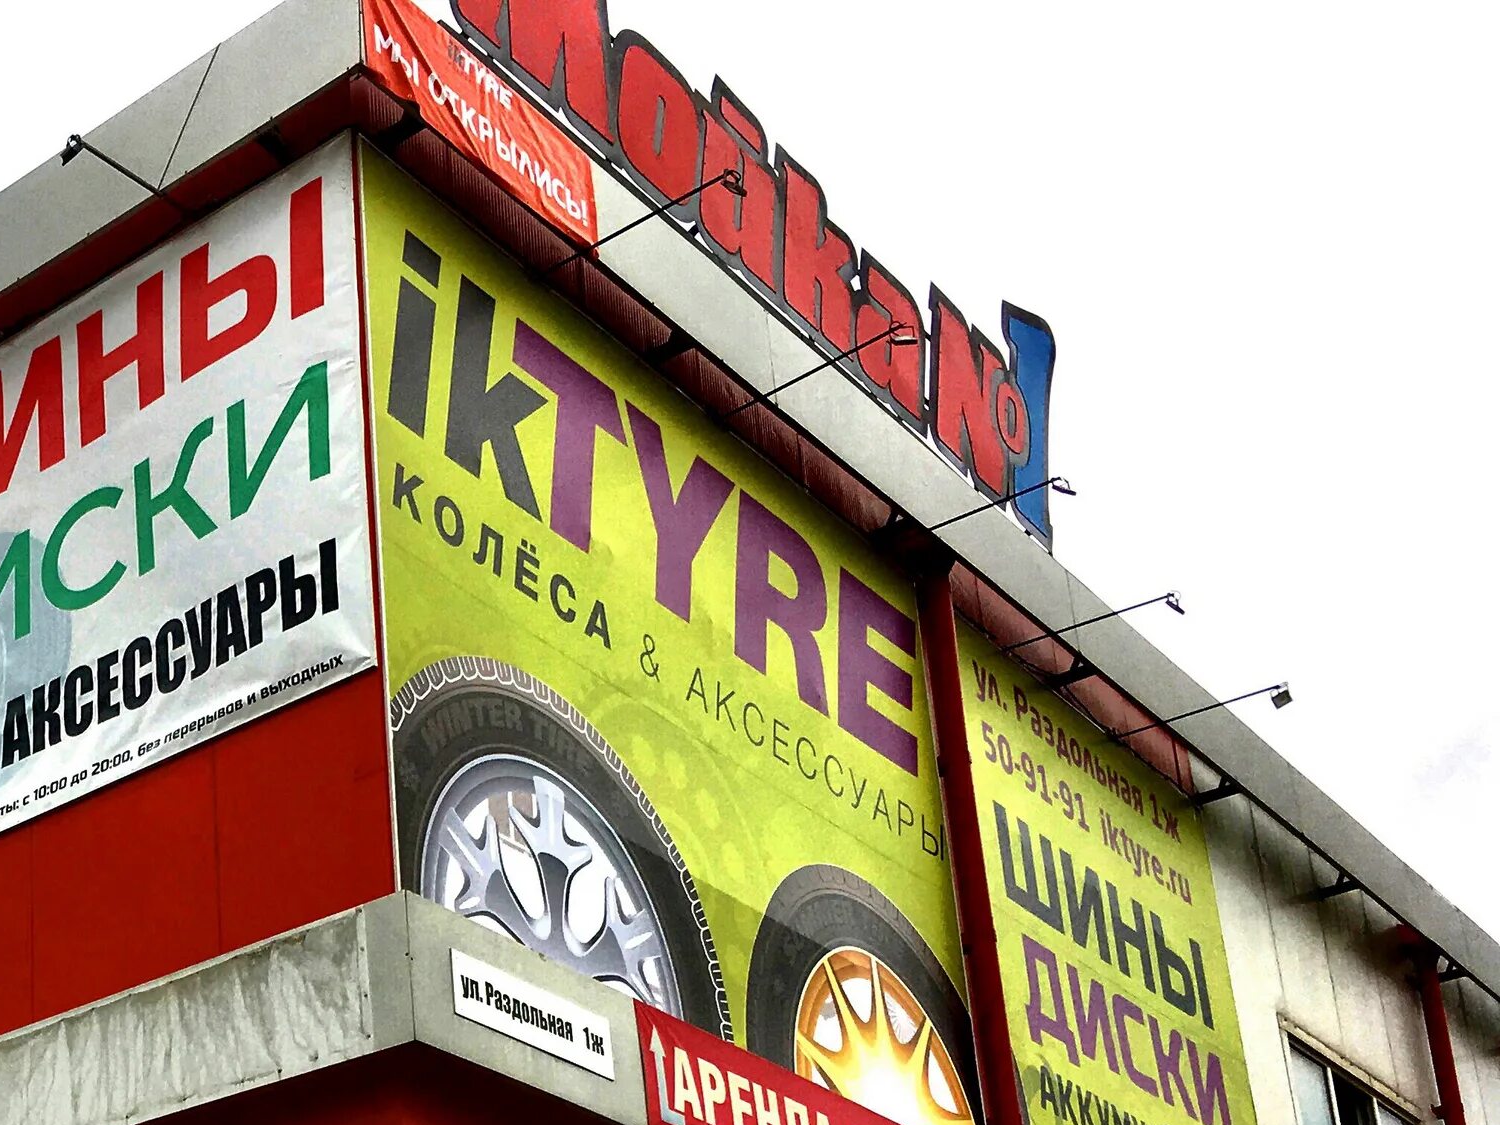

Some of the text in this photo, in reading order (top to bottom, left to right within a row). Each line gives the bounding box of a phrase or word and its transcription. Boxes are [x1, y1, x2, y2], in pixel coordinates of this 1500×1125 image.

[374, 23, 588, 226] МЫ ОТКРЫЛИСЬ!
[386, 229, 919, 778] ikTYRE
[1, 538, 340, 768] АКСЕССУАРЫ
[22, 793, 31, 807] с
[33, 777, 68, 801] 10:00
[69, 769, 89, 791] до
[91, 749, 134, 778] 20:00,
[137, 736, 162, 759] без
[163, 696, 244, 750] перерывов
[245, 691, 258, 708] и
[260, 653, 345, 702] выходных
[391, 461, 946, 862] КОЛЁСА & АКСЕССУАРЫ
[972, 659, 1182, 843] ул. Раздольная 1ж
[981, 719, 1193, 906] 50-91-91 iktyre.ru
[460, 975, 605, 1056] ул. Раздольная 1ж
[993, 799, 1215, 1030] ШИНЫ
